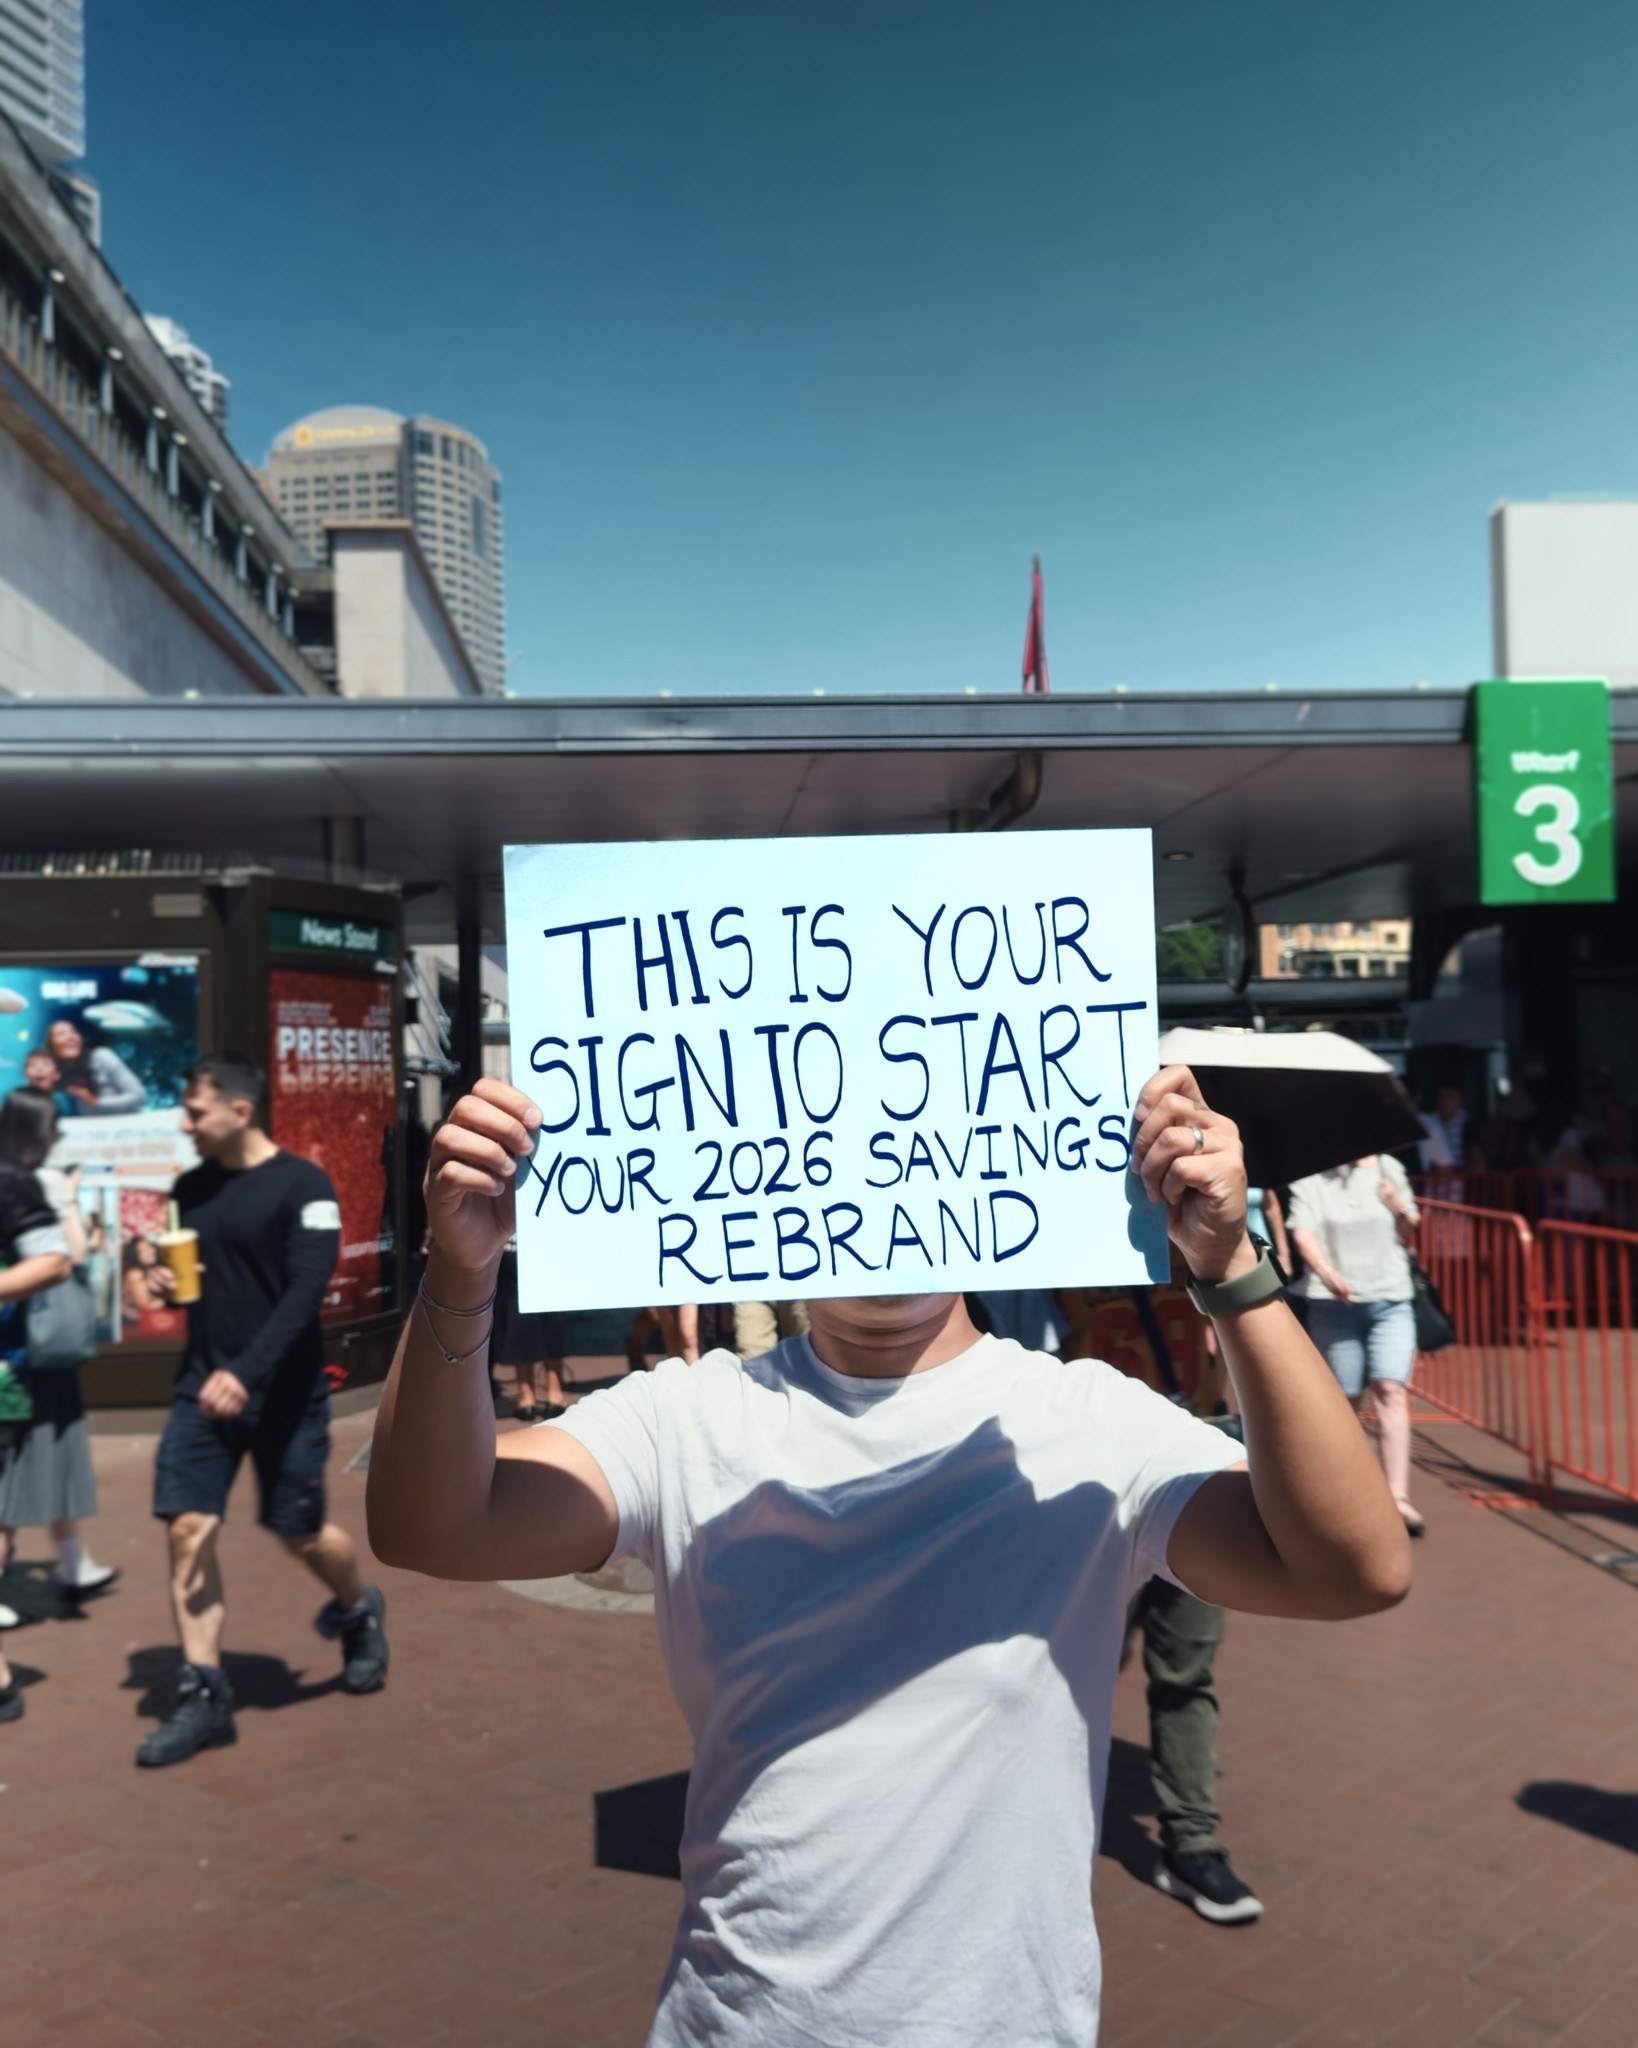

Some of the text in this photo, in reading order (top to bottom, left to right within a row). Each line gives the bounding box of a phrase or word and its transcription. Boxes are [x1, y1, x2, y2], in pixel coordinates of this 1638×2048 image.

[1512, 784, 1582, 886] 3
[301, 920, 379, 950] News Stand
[544, 896, 1112, 1018] THIS IS YOUR
[278, 1026, 392, 1062] PRESENCE
[531, 1001, 1147, 1136] SIGN TO START
[526, 1114, 1130, 1217] YOUR 2026 SAVINGS
[658, 1190, 1039, 1288] REBRAND
